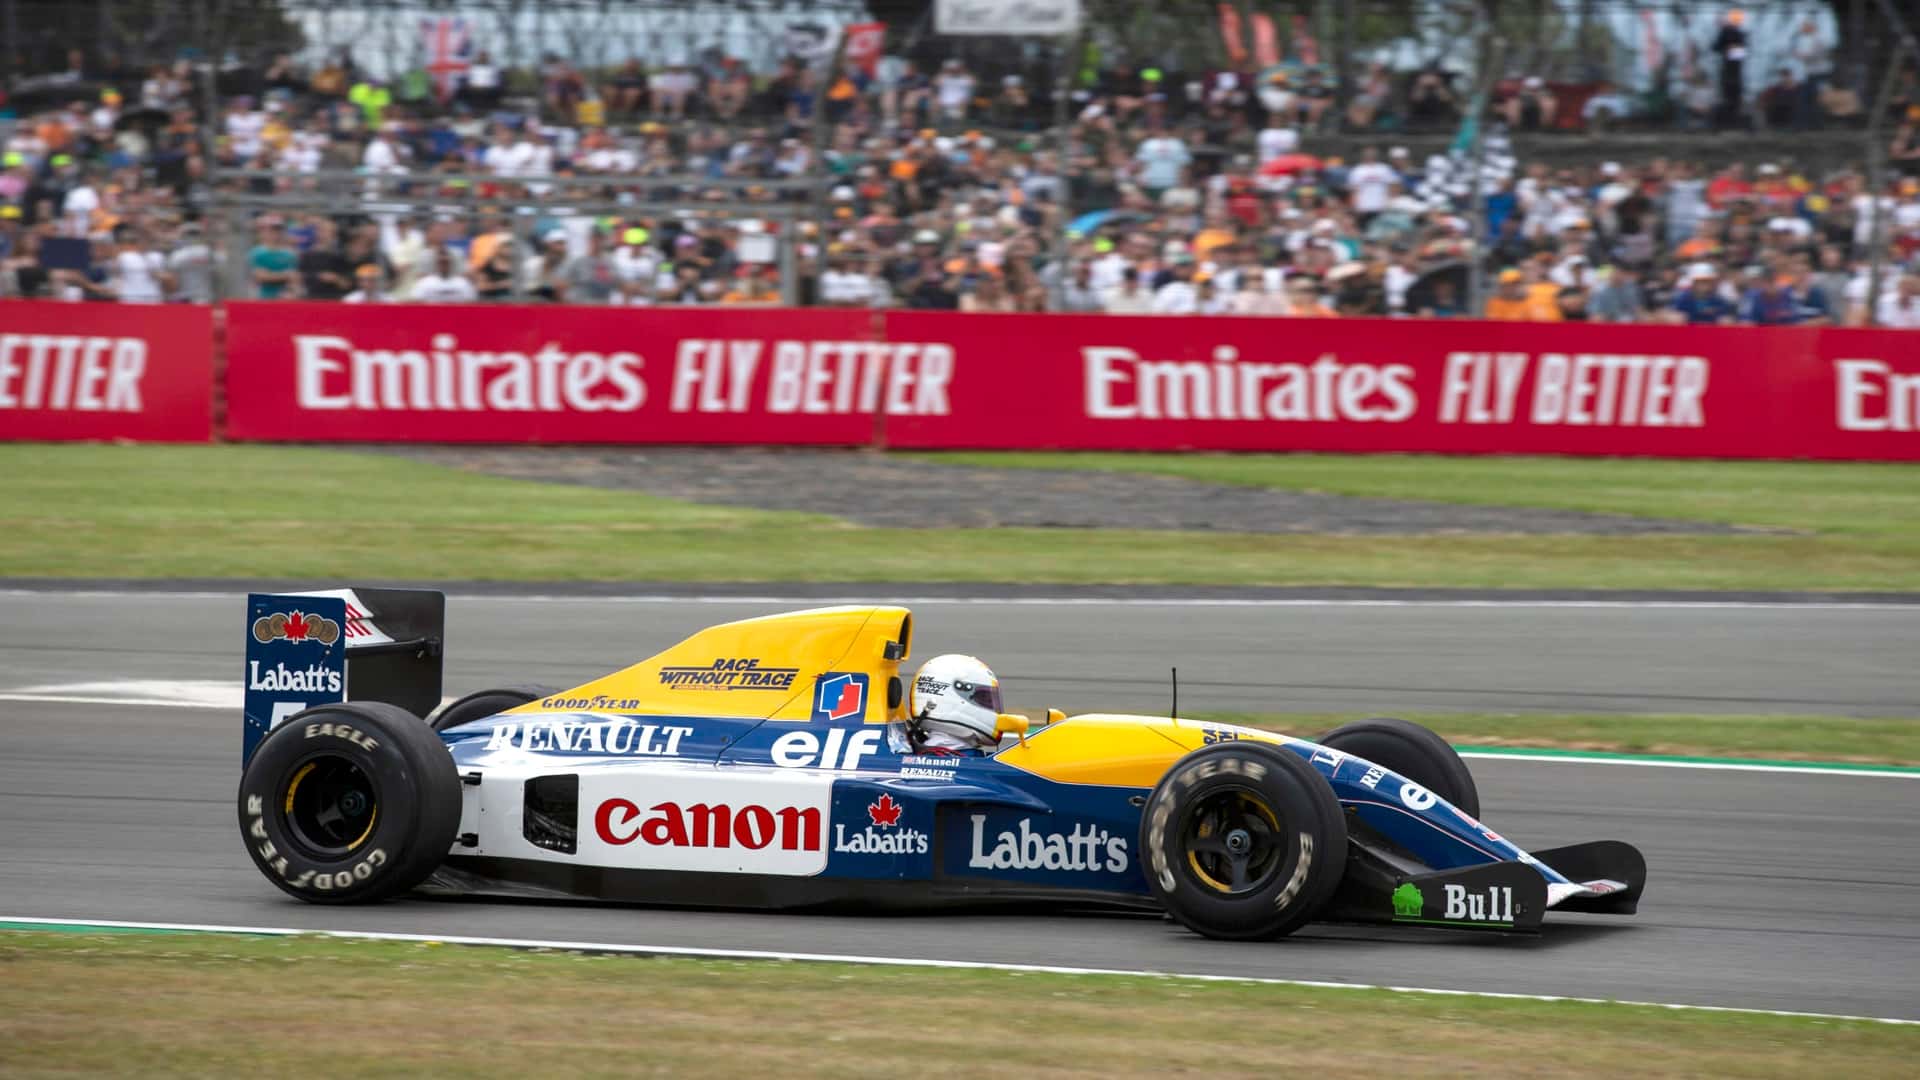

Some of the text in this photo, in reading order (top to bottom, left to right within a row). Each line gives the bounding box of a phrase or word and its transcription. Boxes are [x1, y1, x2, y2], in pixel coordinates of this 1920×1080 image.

[295, 334, 954, 416] Emirates FLY BETTER
[1083, 346, 1709, 427] Emirates FLY BETTER
[249, 660, 342, 693] Labatt's
[659, 671, 797, 686] WITHOUT TRACE
[712, 658, 760, 671] RACE
[304, 723, 379, 750] EAGLE
[482, 723, 693, 757] RENAULT
[770, 728, 882, 770] elf
[901, 768, 956, 778] RENAULT
[914, 756, 960, 767] Mansell
[595, 798, 821, 851] Canon
[834, 823, 929, 855] Labatt's
[969, 814, 1129, 873] Labatt's
[1444, 884, 1515, 922] Bull
